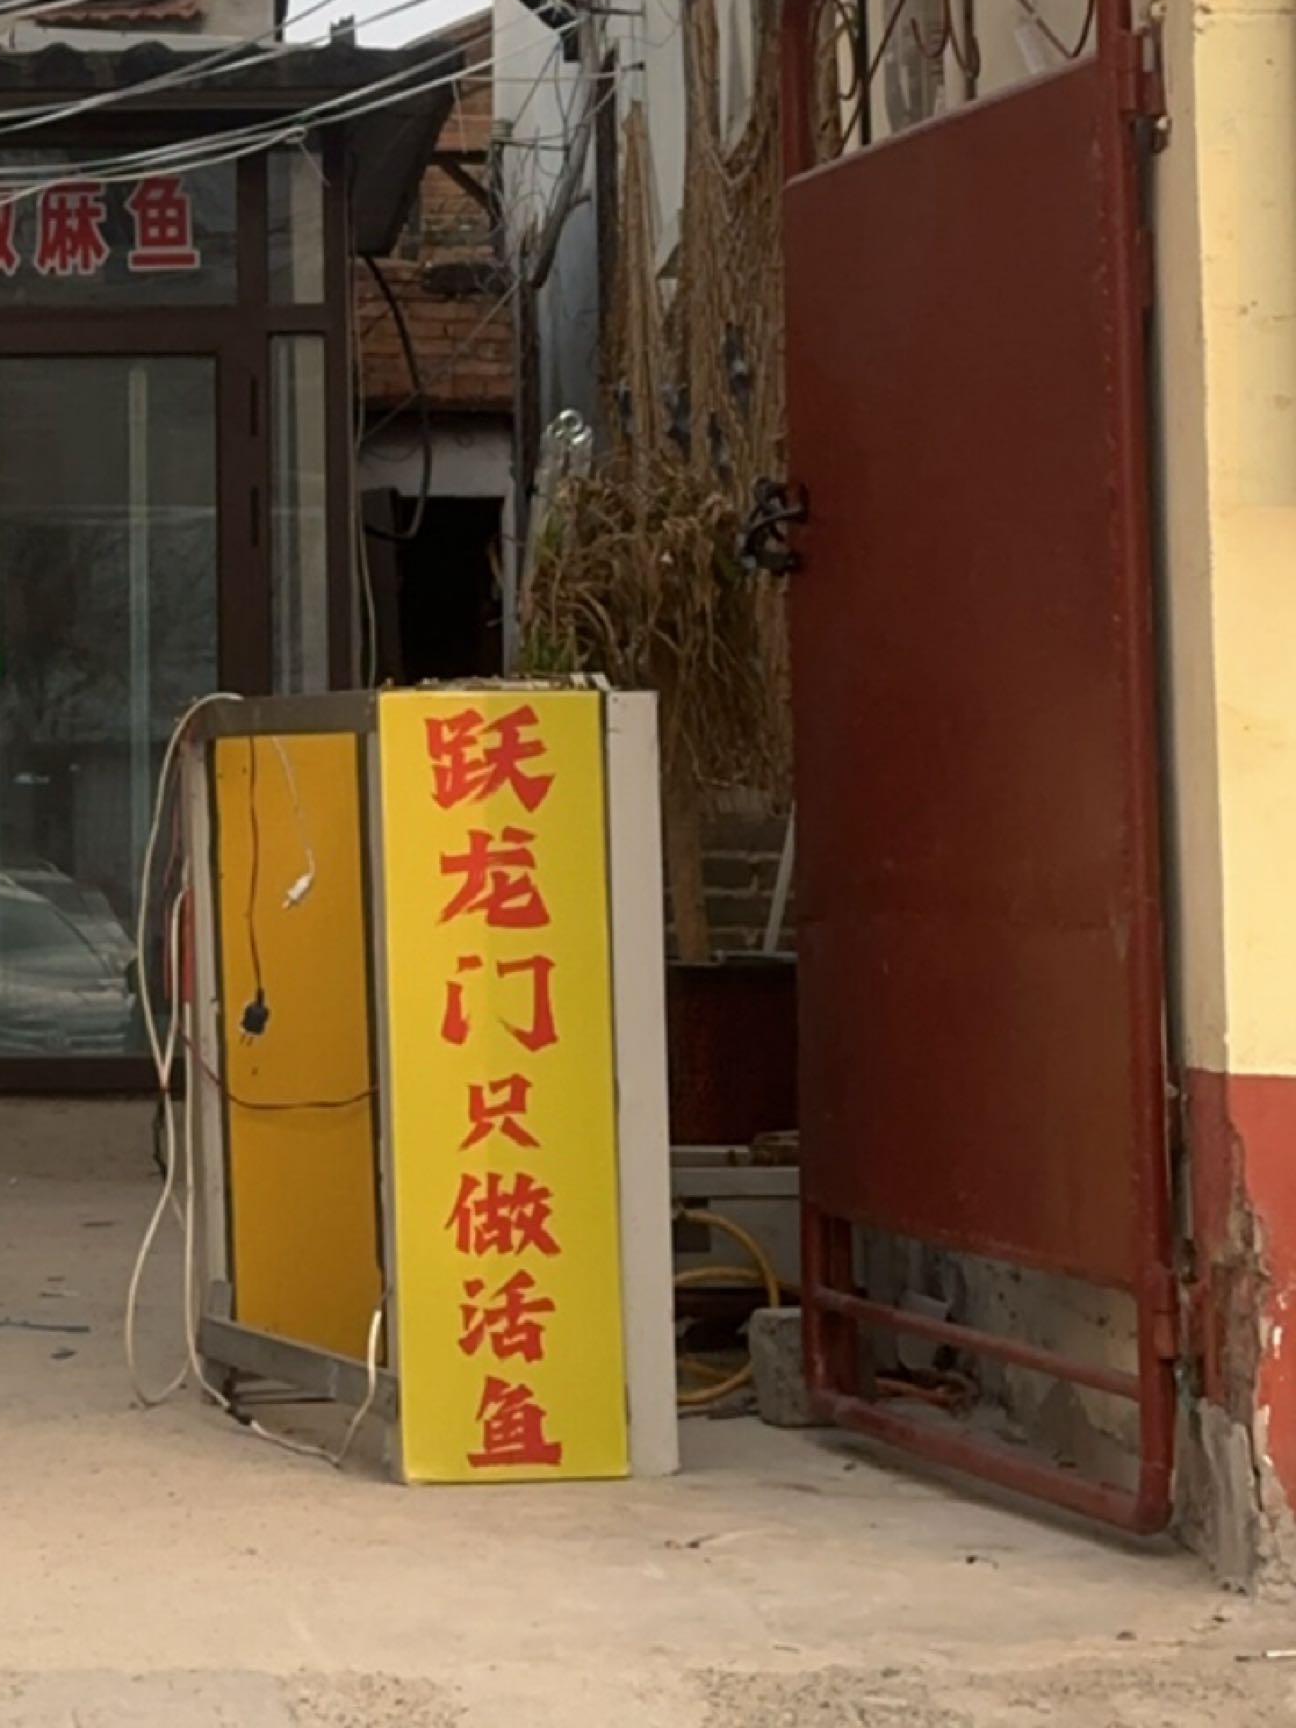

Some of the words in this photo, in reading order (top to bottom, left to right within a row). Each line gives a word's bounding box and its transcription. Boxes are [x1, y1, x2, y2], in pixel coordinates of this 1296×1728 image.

[424, 703, 564, 1470] 跃龙门只做活鱼
